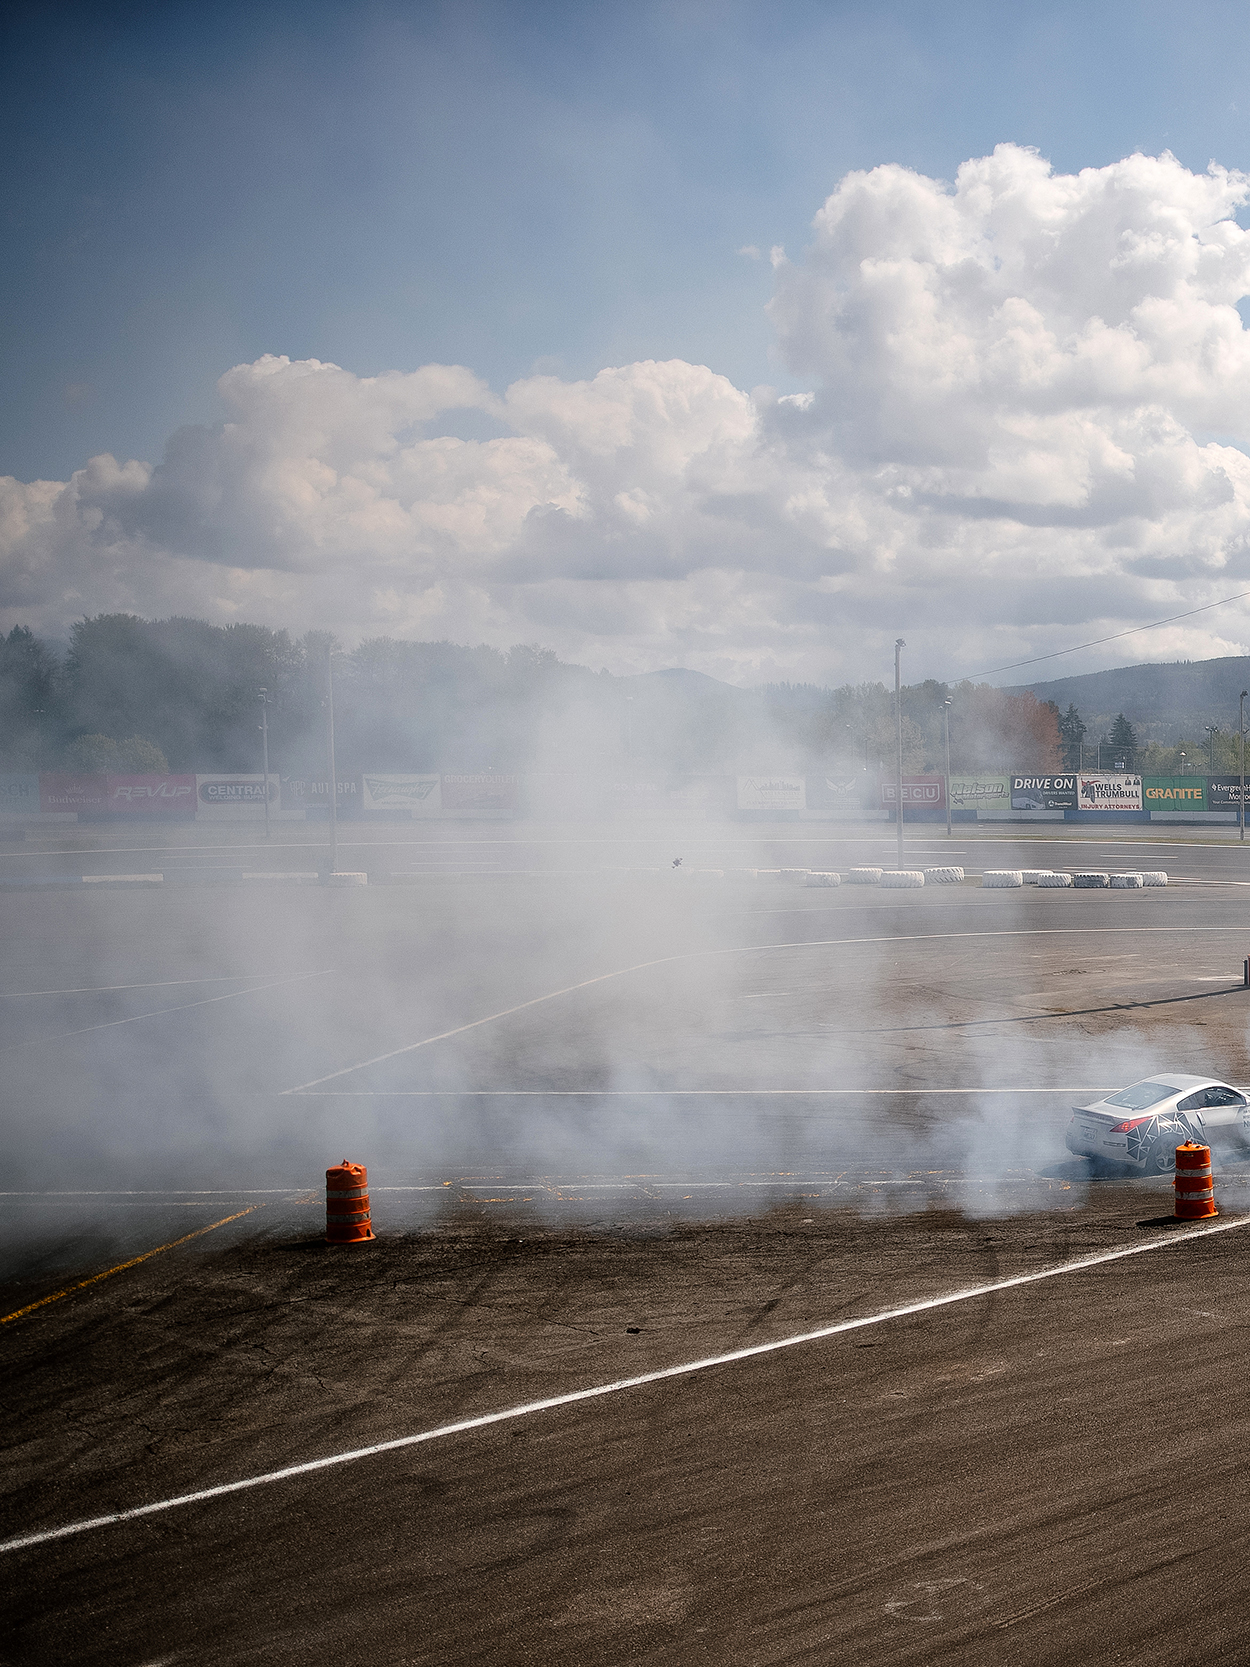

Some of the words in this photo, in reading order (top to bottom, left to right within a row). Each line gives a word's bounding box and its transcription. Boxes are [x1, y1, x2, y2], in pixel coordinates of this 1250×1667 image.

[337, 782, 357, 794] SPA
[951, 782, 1004, 795] Nelson
[1014, 779, 1051, 789] DRIVE
[1053, 779, 1074, 789] ON
[1095, 783, 1122, 791] WELLS
[1095, 790, 1139, 798] TRUMBULL
[1146, 788, 1203, 799] GRANITE
[48, 795, 102, 804] Budweiser
